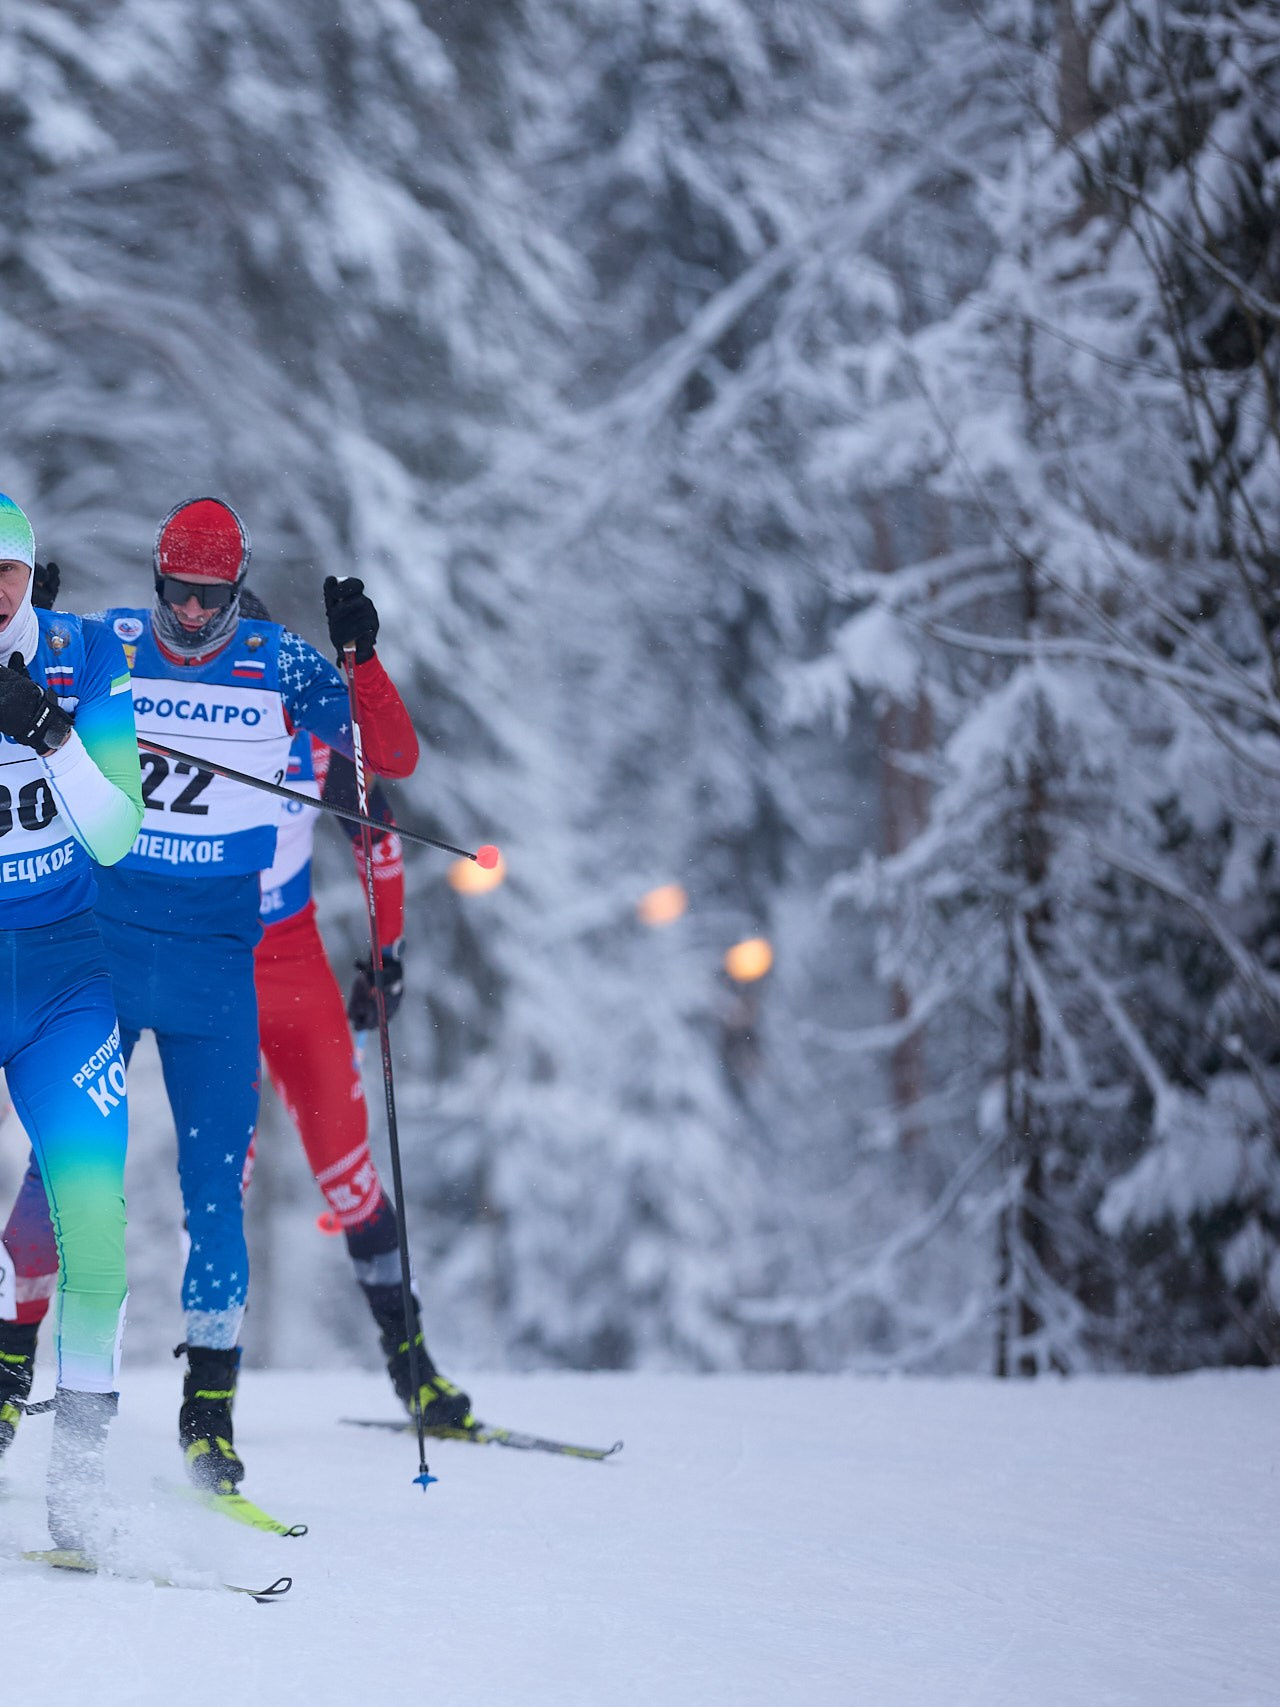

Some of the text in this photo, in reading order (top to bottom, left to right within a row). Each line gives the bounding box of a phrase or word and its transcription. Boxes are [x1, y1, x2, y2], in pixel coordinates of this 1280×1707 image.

[133, 696, 261, 727] ФОСАГРО
[139, 753, 216, 816] 22
[351, 719, 369, 818] SWIX
[129, 833, 225, 865] ПЕЦКОЕ
